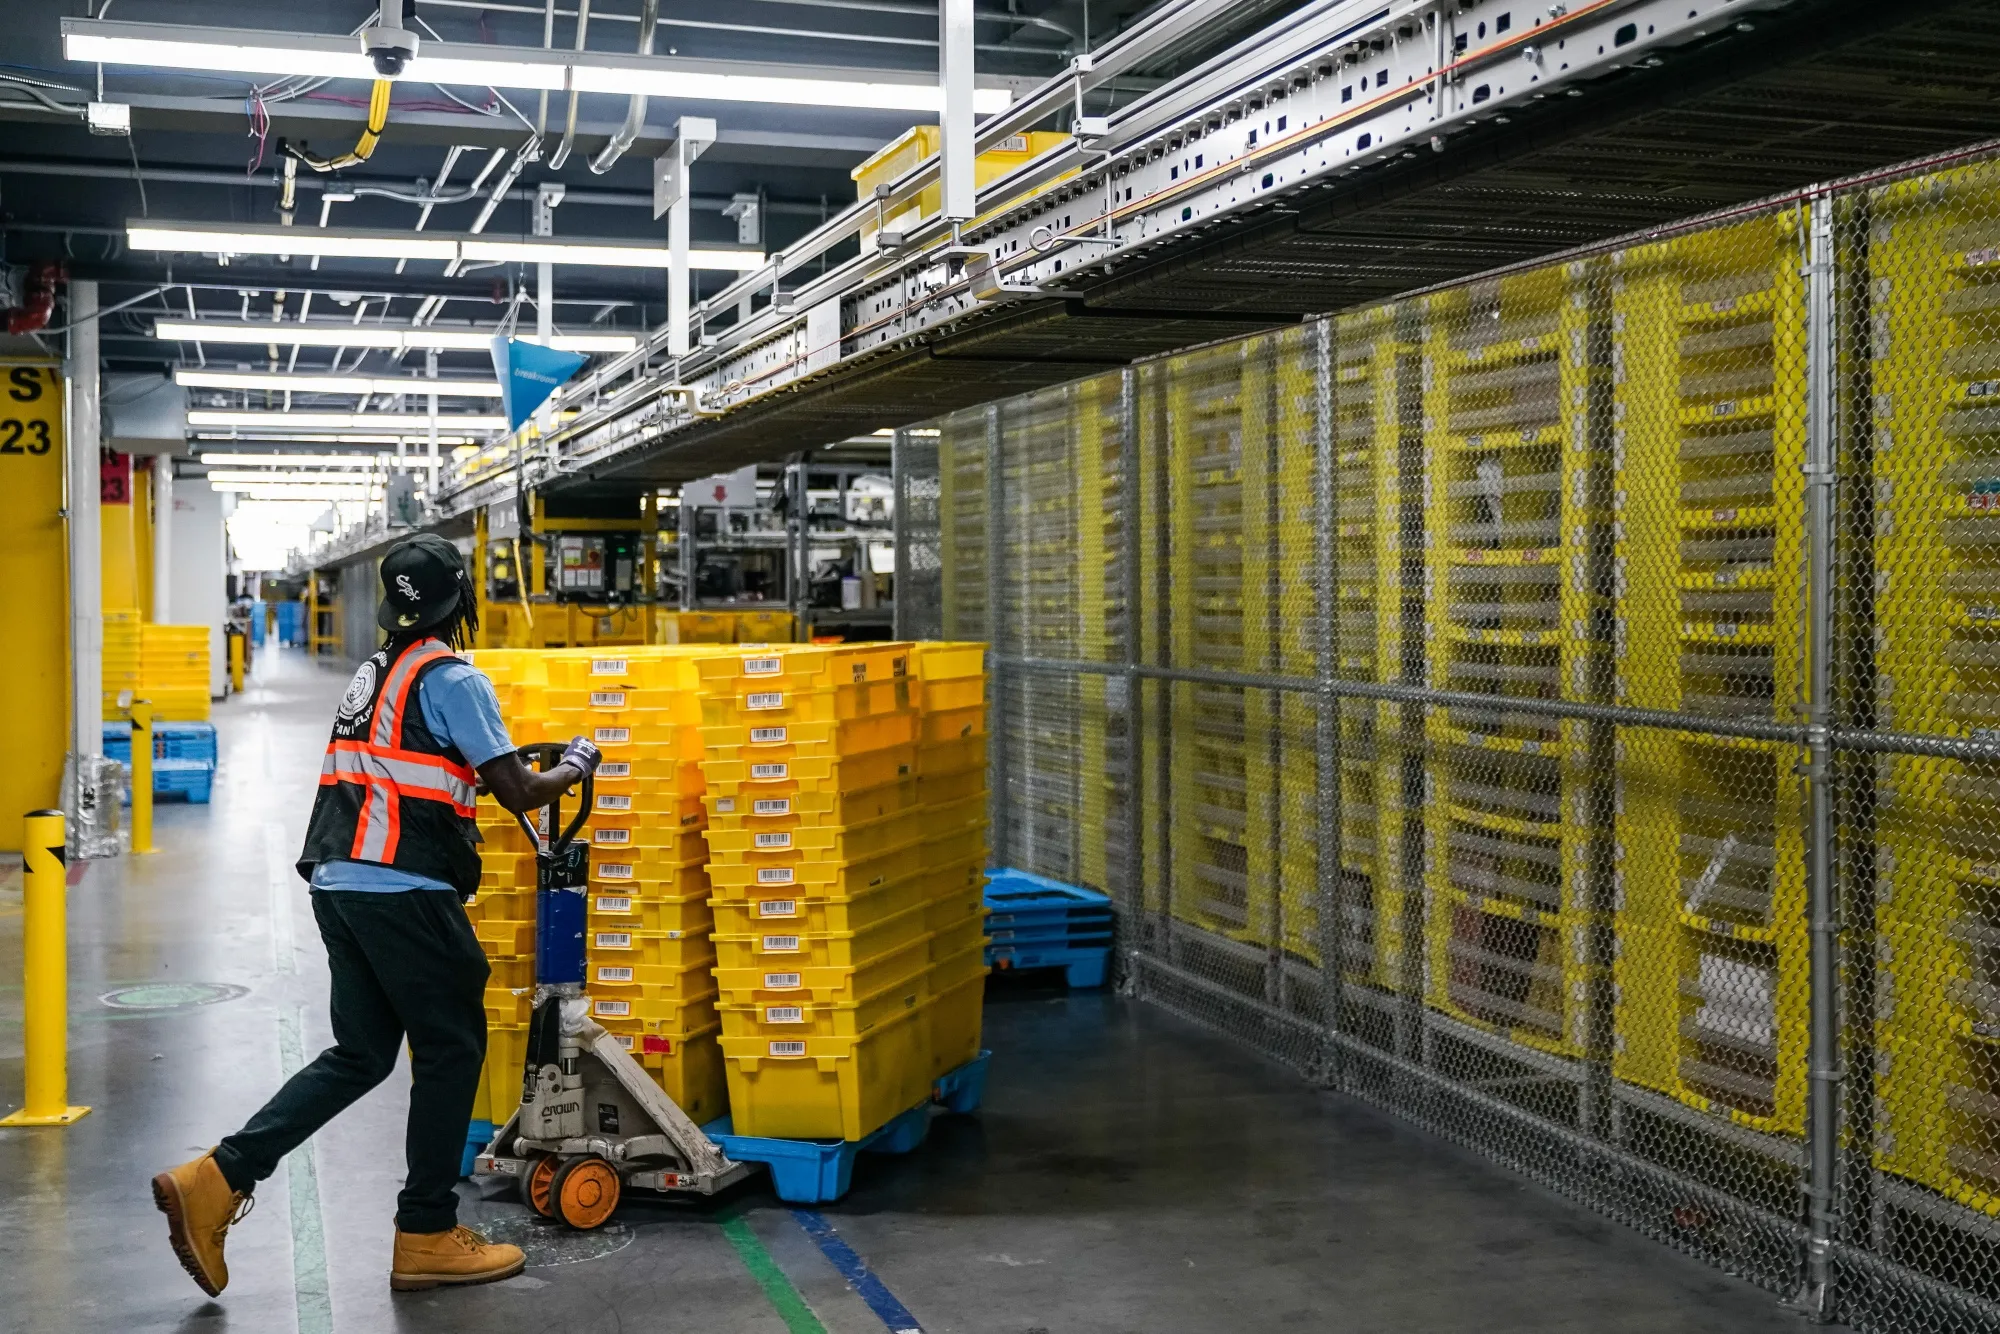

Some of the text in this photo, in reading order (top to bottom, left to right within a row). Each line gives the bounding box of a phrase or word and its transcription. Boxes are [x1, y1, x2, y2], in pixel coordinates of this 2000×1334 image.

[9, 367, 42, 402] S
[514, 368, 558, 385] breakroom
[0, 419, 51, 455] 23
[396, 574, 421, 601] Sox
[541, 1101, 580, 1117] CROWN
